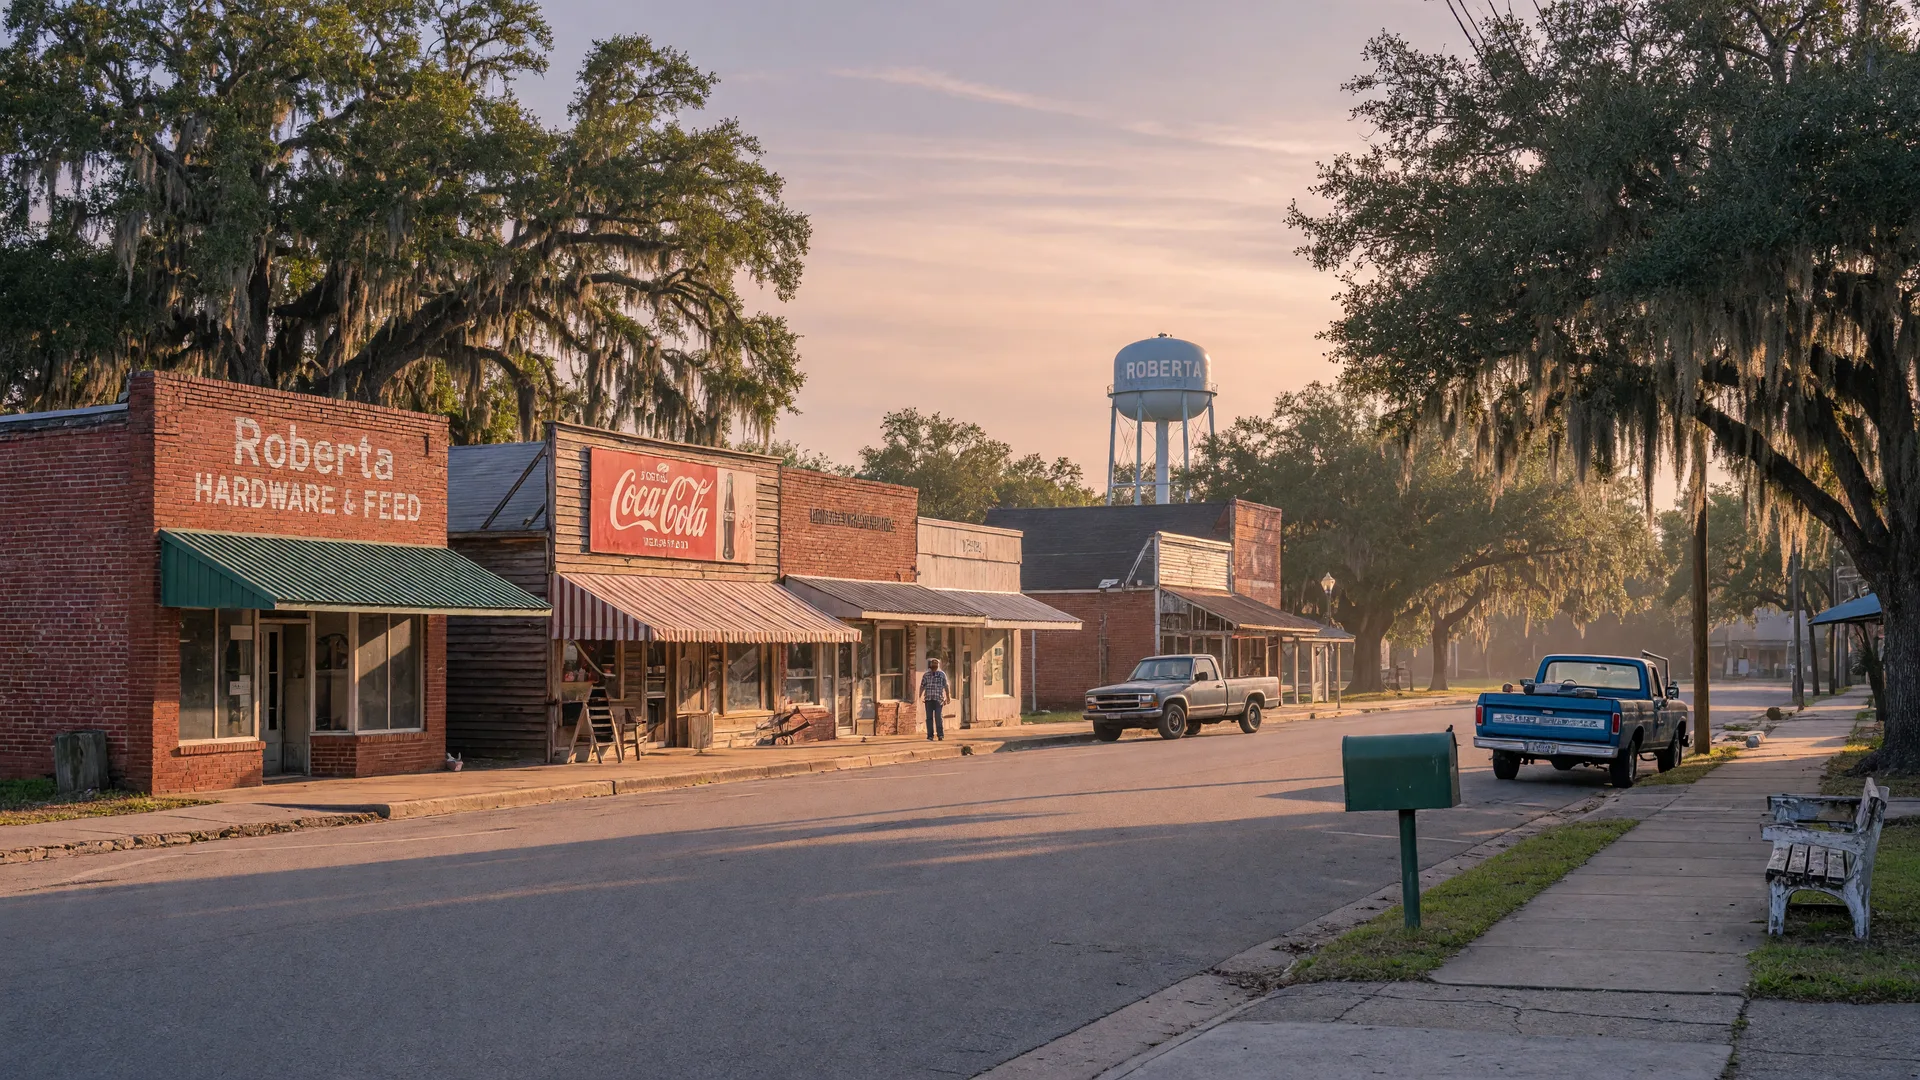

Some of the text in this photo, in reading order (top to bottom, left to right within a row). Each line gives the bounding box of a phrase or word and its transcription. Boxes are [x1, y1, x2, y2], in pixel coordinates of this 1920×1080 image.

[1126, 360, 1202, 380] ROBERTA
[234, 416, 393, 480] Roberta
[195, 472, 422, 522] HARDWARE & FEED
[610, 469, 714, 537] Coca-Cola
